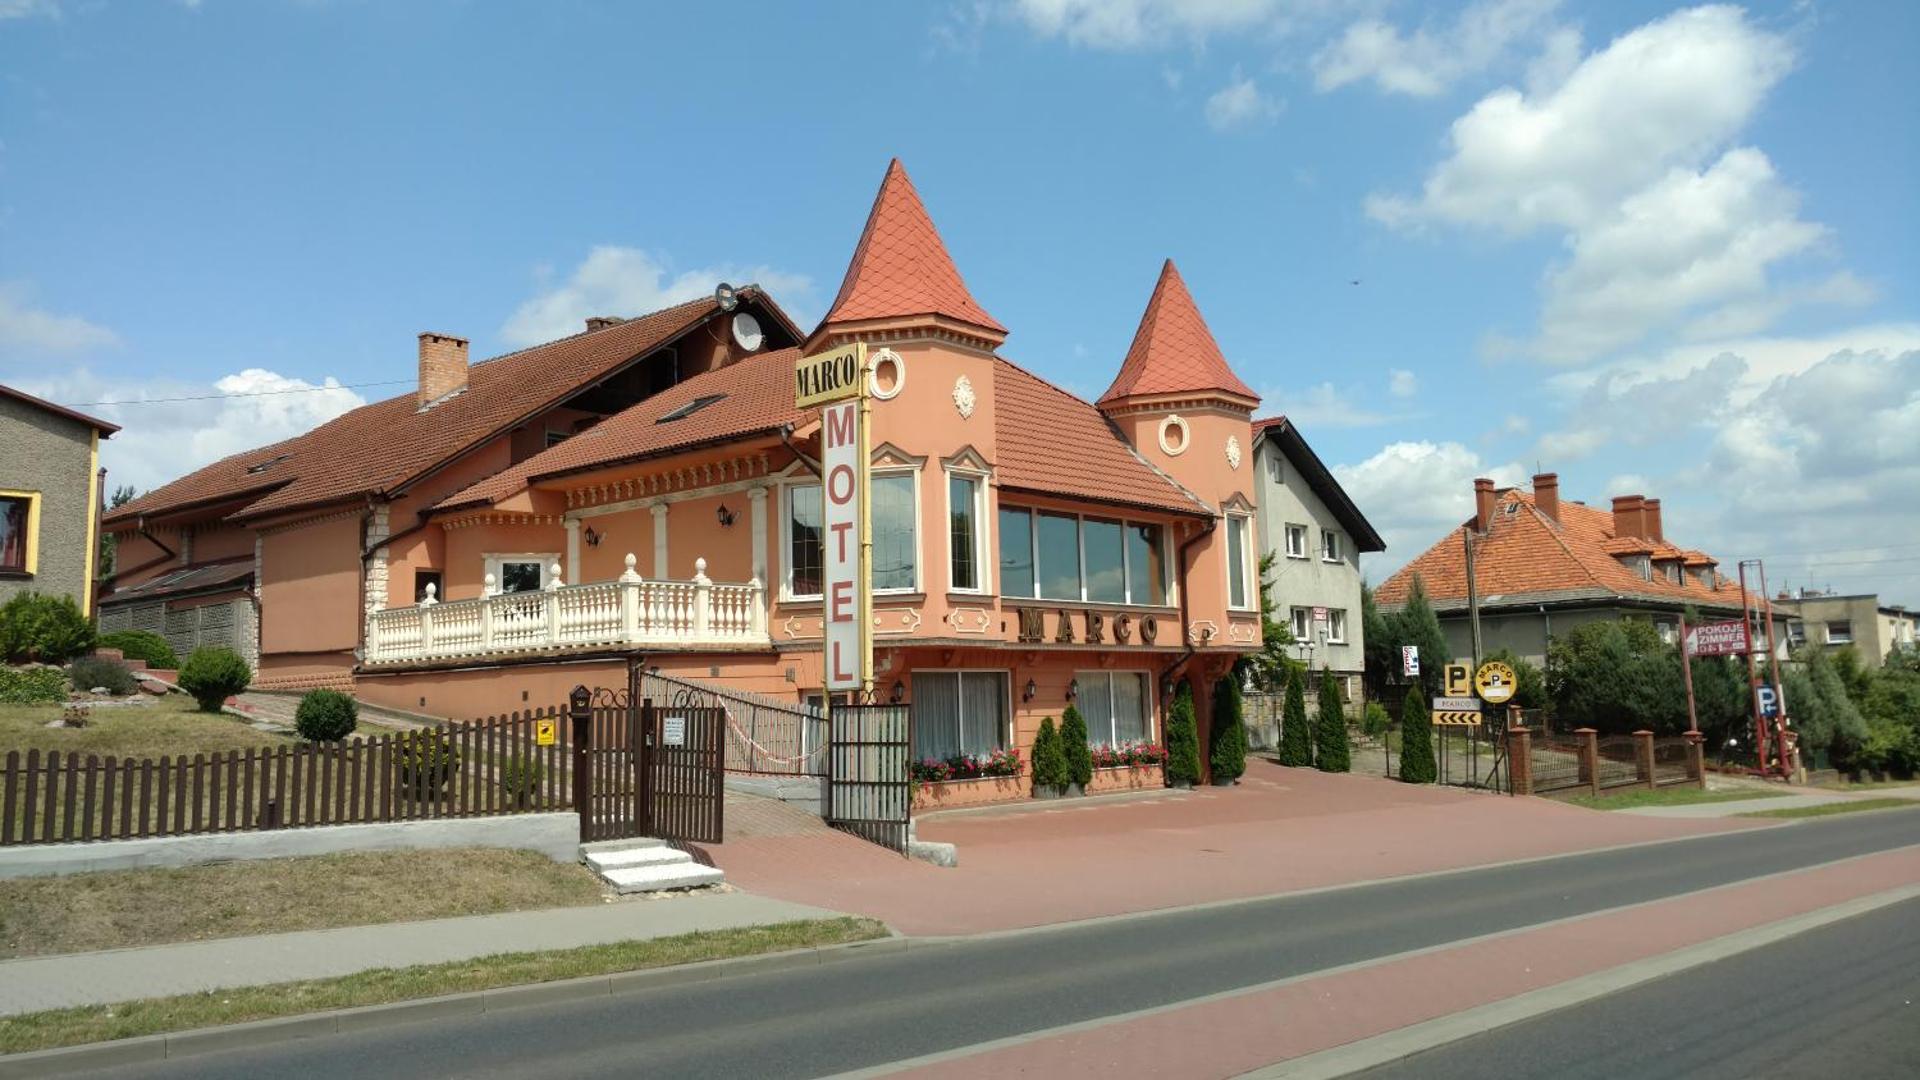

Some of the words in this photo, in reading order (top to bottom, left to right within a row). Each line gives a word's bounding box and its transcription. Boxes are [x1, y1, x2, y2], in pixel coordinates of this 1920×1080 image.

[796, 354, 855, 398] MARCO
[827, 405, 855, 682] MOTEL
[1018, 608, 1158, 643] MARCO
[1697, 623, 1745, 635] POKOJE
[1699, 633, 1746, 645] ZIMMER
[1448, 666, 1467, 689] P
[1479, 663, 1513, 679] MARCO
[1491, 675, 1500, 686] P
[1757, 687, 1777, 714] P
